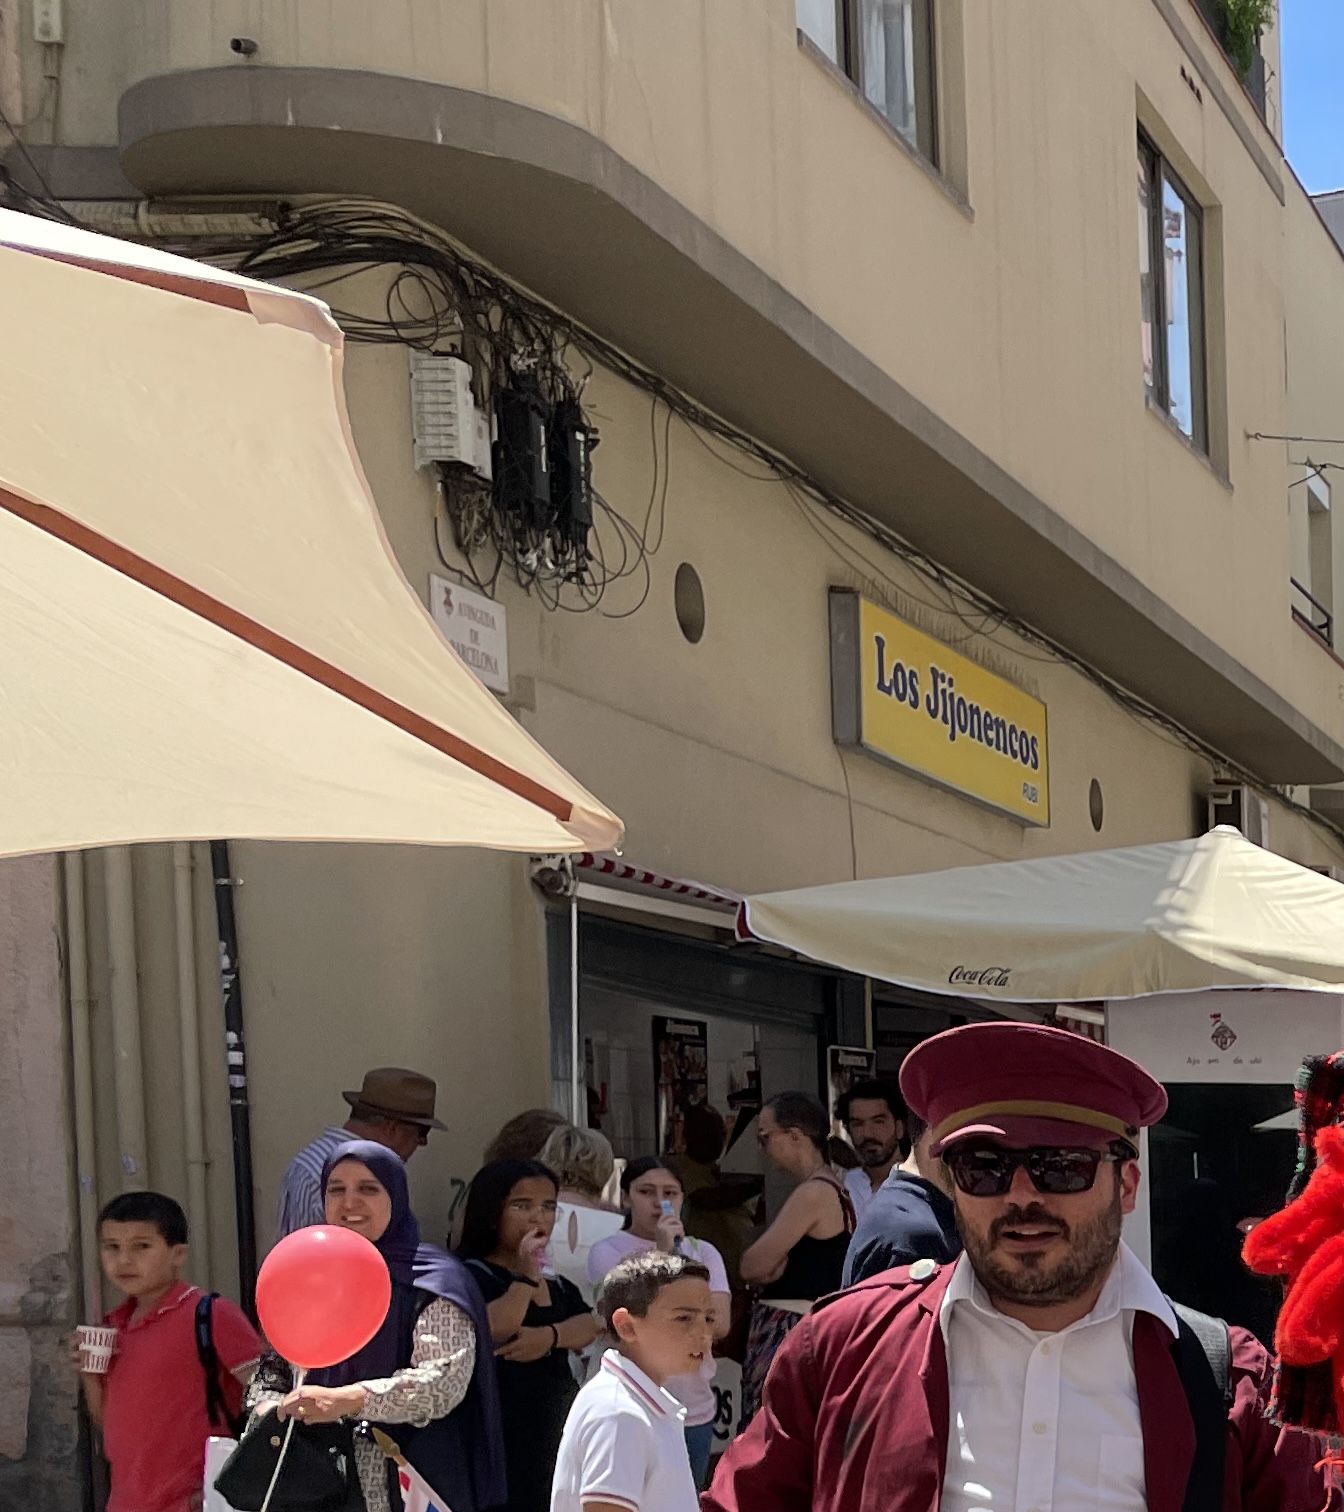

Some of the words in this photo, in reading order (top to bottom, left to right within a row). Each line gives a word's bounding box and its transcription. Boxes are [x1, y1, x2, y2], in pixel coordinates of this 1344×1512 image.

[874, 635, 919, 710] Los
[925, 666, 1039, 771] Jijonencos
[948, 965, 1012, 986] Coca-Cola
